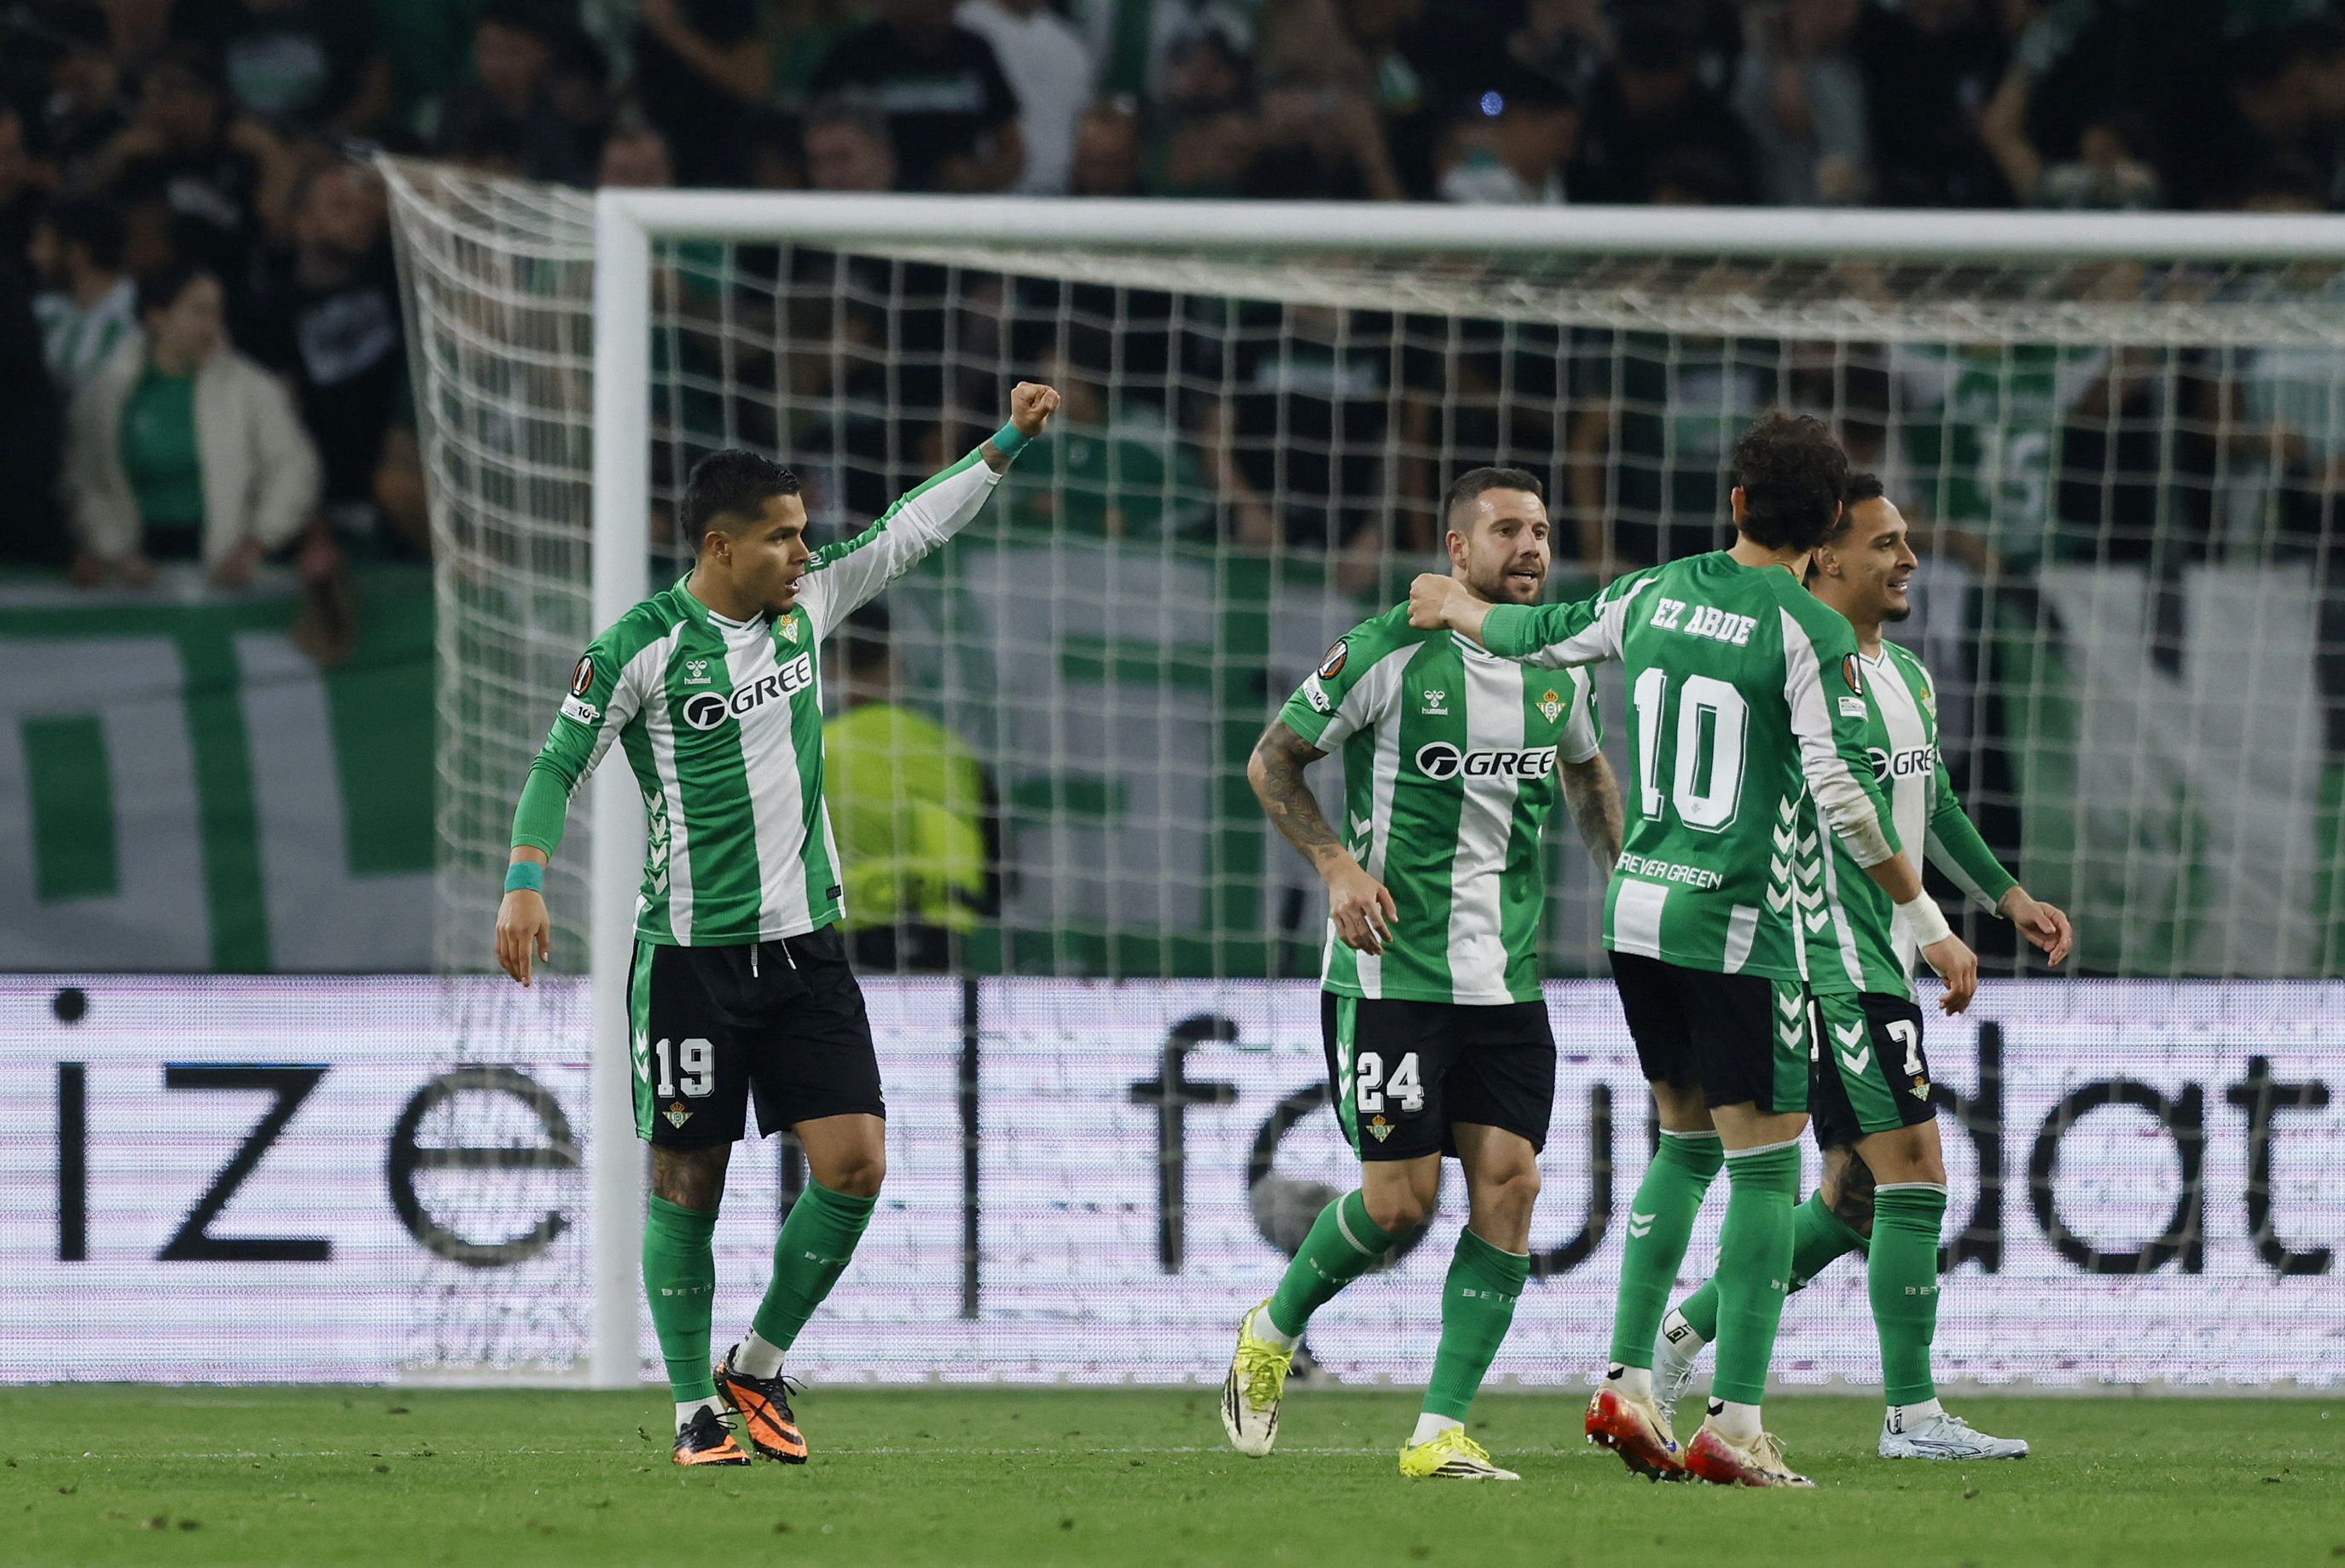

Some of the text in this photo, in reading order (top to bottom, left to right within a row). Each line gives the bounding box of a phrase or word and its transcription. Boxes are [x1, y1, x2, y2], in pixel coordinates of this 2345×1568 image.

[1650, 597, 1686, 632] EZ
[1684, 605, 1757, 648] ABDE
[684, 676, 711, 685] hummel
[731, 656, 810, 715] GREE
[1421, 706, 1448, 716] hummel
[1463, 750, 1557, 775] GREE
[1634, 667, 1750, 833] 10
[1893, 748, 1934, 775] GRE
[1666, 863, 1723, 891] GREEN
[655, 1037, 716, 1099] 19
[1885, 1019, 1924, 1077] 7
[1356, 1051, 1425, 1114] 24
[52, 987, 806, 1267] ize
[661, 1282, 712, 1297] BETIS
